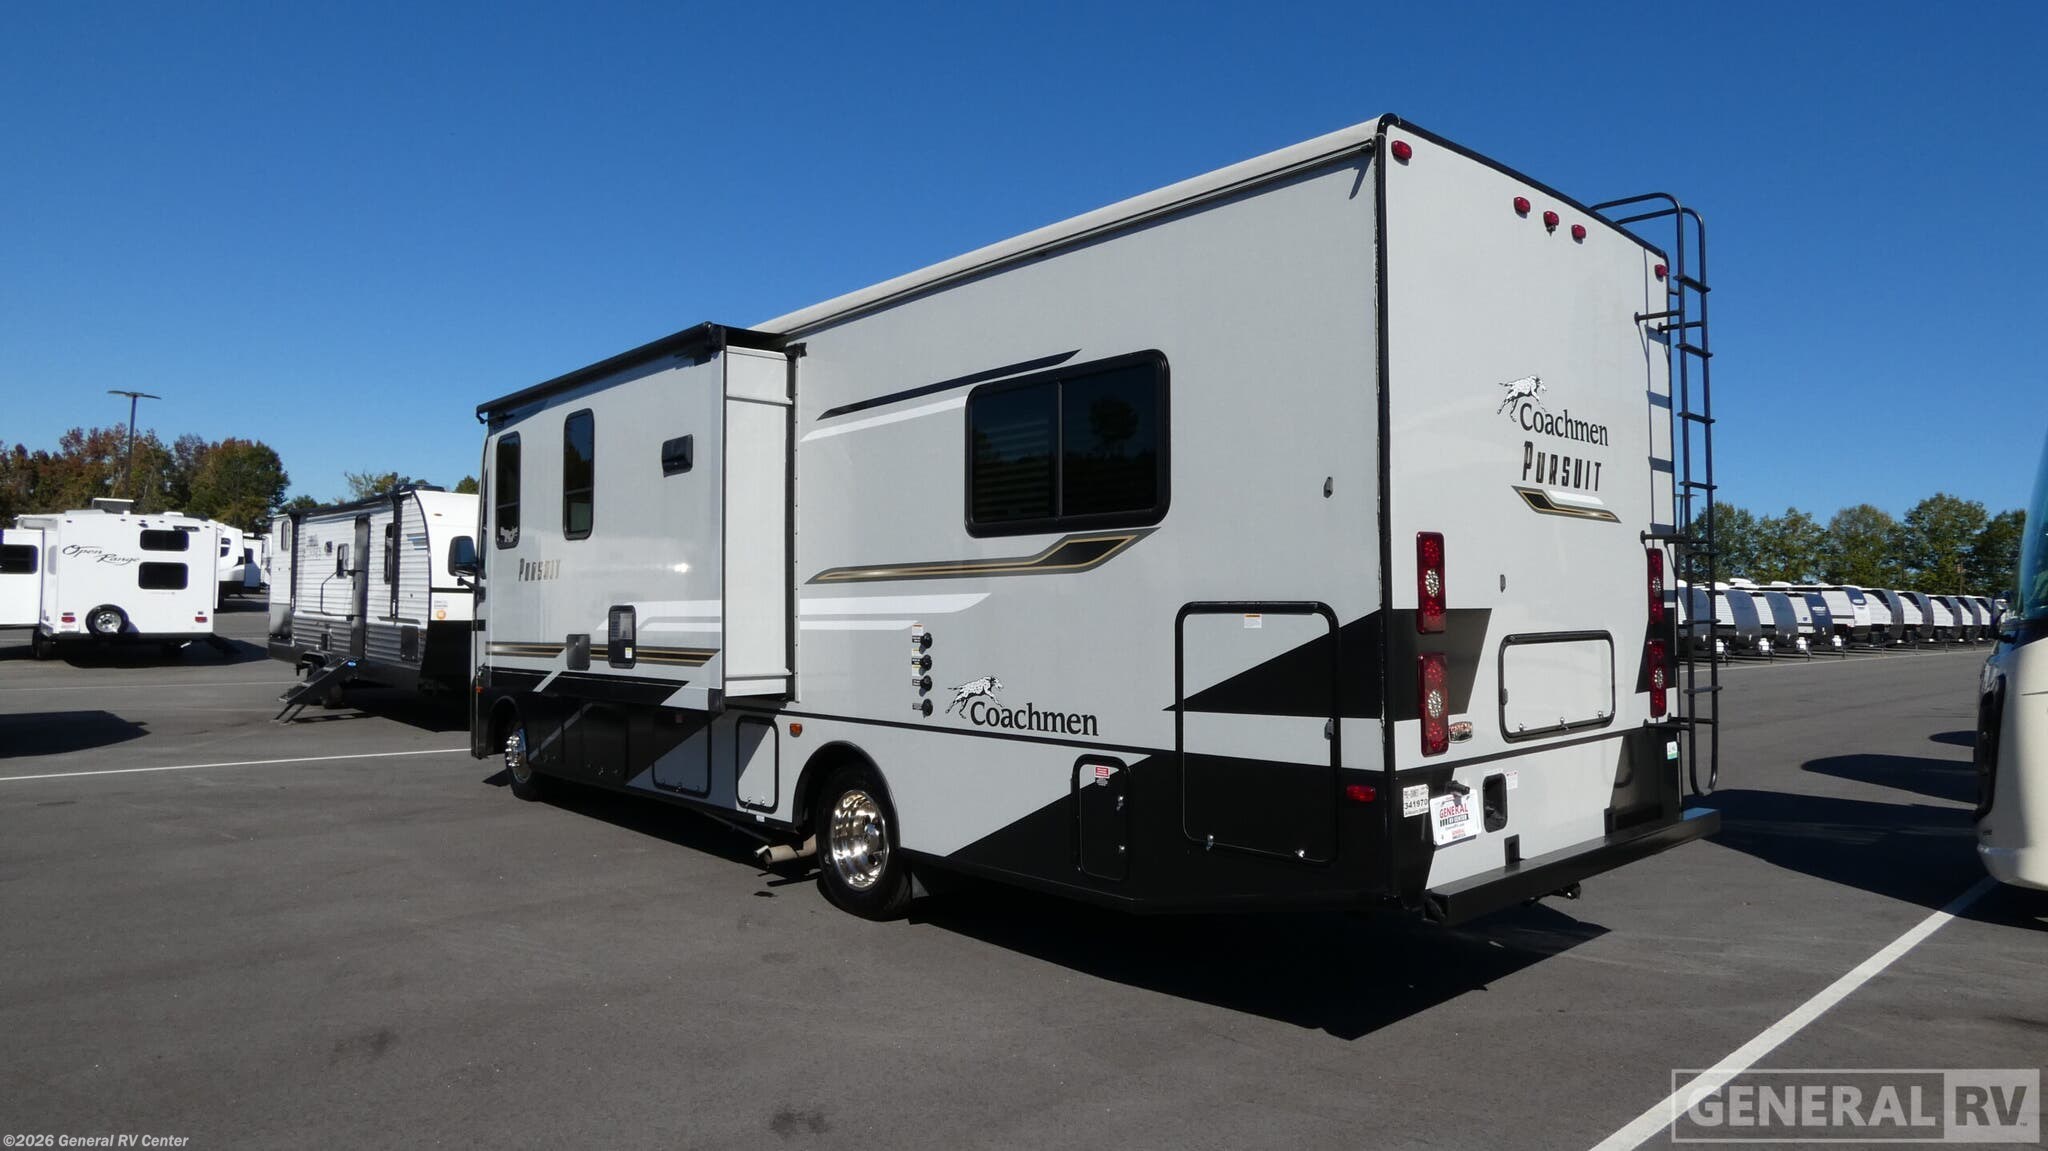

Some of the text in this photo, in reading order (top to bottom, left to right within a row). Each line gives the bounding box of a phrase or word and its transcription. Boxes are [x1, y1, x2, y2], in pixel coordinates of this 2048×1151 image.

[1520, 402, 1608, 446] Coachmen
[1522, 441, 1601, 492] PURSUIT
[62, 544, 103, 558] Open
[96, 553, 140, 566] Range
[970, 701, 1099, 736] Coachmen
[1440, 804, 1468, 819] GENERAL
